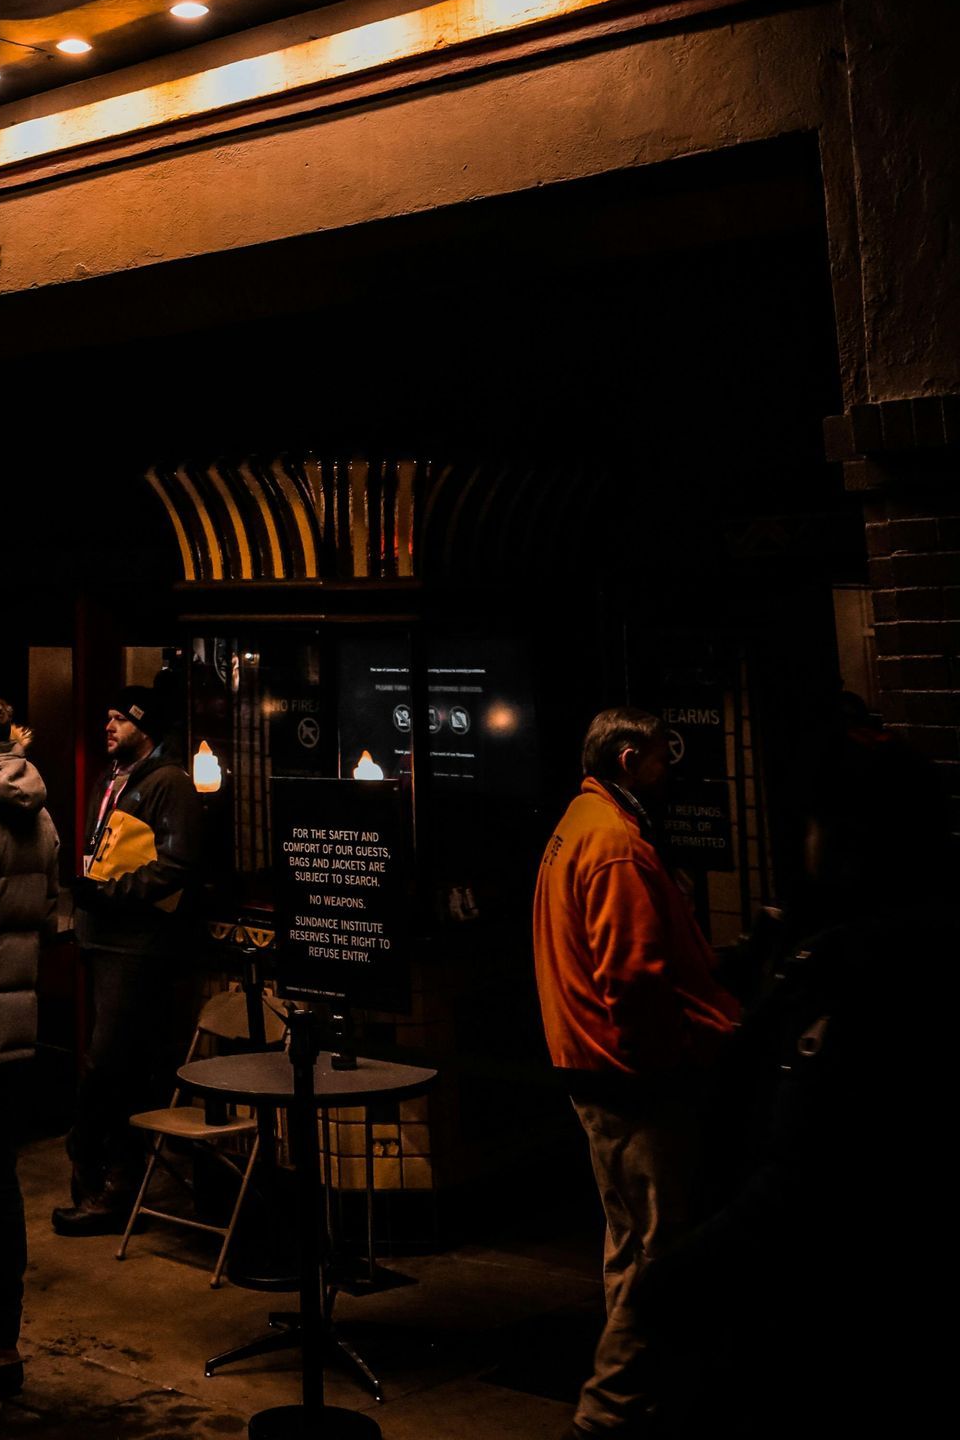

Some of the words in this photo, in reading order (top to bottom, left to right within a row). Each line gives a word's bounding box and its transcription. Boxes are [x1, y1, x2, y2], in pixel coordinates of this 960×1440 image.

[292, 827, 309, 839] FOR
[311, 828, 327, 840] THE
[328, 829, 359, 841] SAFETY
[360, 831, 380, 842] AND
[282, 841, 320, 855] COMFORT
[322, 843, 334, 855] OF
[335, 844, 354, 856] OUR
[355, 846, 391, 860] GUESTS,
[289, 856, 310, 868] BAGS
[312, 857, 330, 869] AND
[331, 858, 367, 872] JACKETS
[368, 861, 386, 873] ARE
[294, 870, 330, 882] SUBJECT
[331, 872, 343, 884] TO
[344, 874, 381, 887] SEARCH.
[309, 894, 322, 905] NO
[323, 895, 367, 909] WEAPONS.
[295, 915, 339, 930] SUNDANCE
[340, 919, 384, 934] INSTITUTE
[289, 929, 330, 943] RESERVES
[331, 933, 349, 945] THE
[350, 935, 376, 948] RIGHT
[378, 938, 391, 950] TO
[308, 946, 340, 959] REFUSE
[341, 949, 371, 963] ENTRY.
